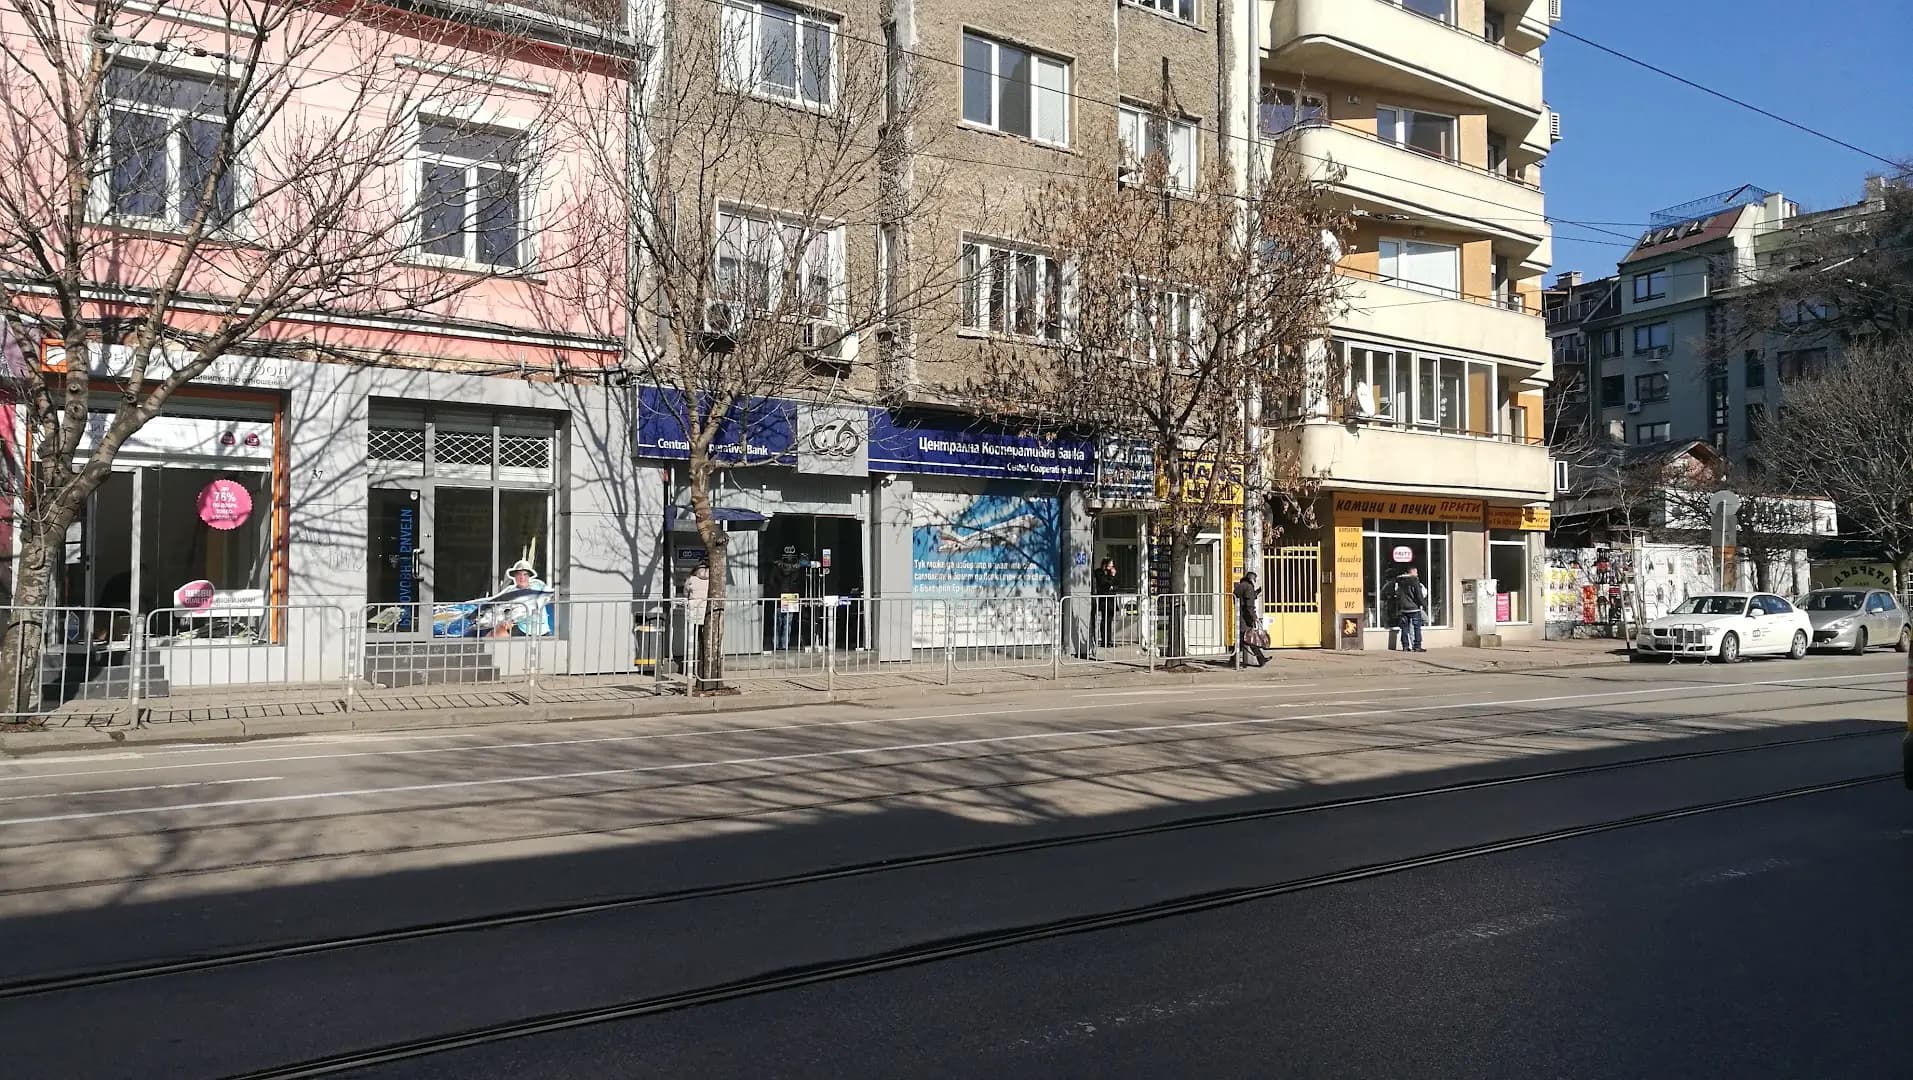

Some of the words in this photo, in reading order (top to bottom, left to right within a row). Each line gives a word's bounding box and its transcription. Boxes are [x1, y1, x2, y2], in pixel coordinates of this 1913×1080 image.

[657, 438, 690, 450] Central
[746, 444, 769, 456] Bank
[919, 436, 980, 454] Централна
[981, 441, 1056, 459] Кооперативна
[312, 468, 324, 480] 37
[1335, 499, 1385, 513] камини
[1388, 502, 1397, 514] и
[1400, 503, 1436, 517] печки
[1439, 500, 1482, 514] ПРИТИ
[1833, 565, 1891, 587] ДЪБЧЕТО
